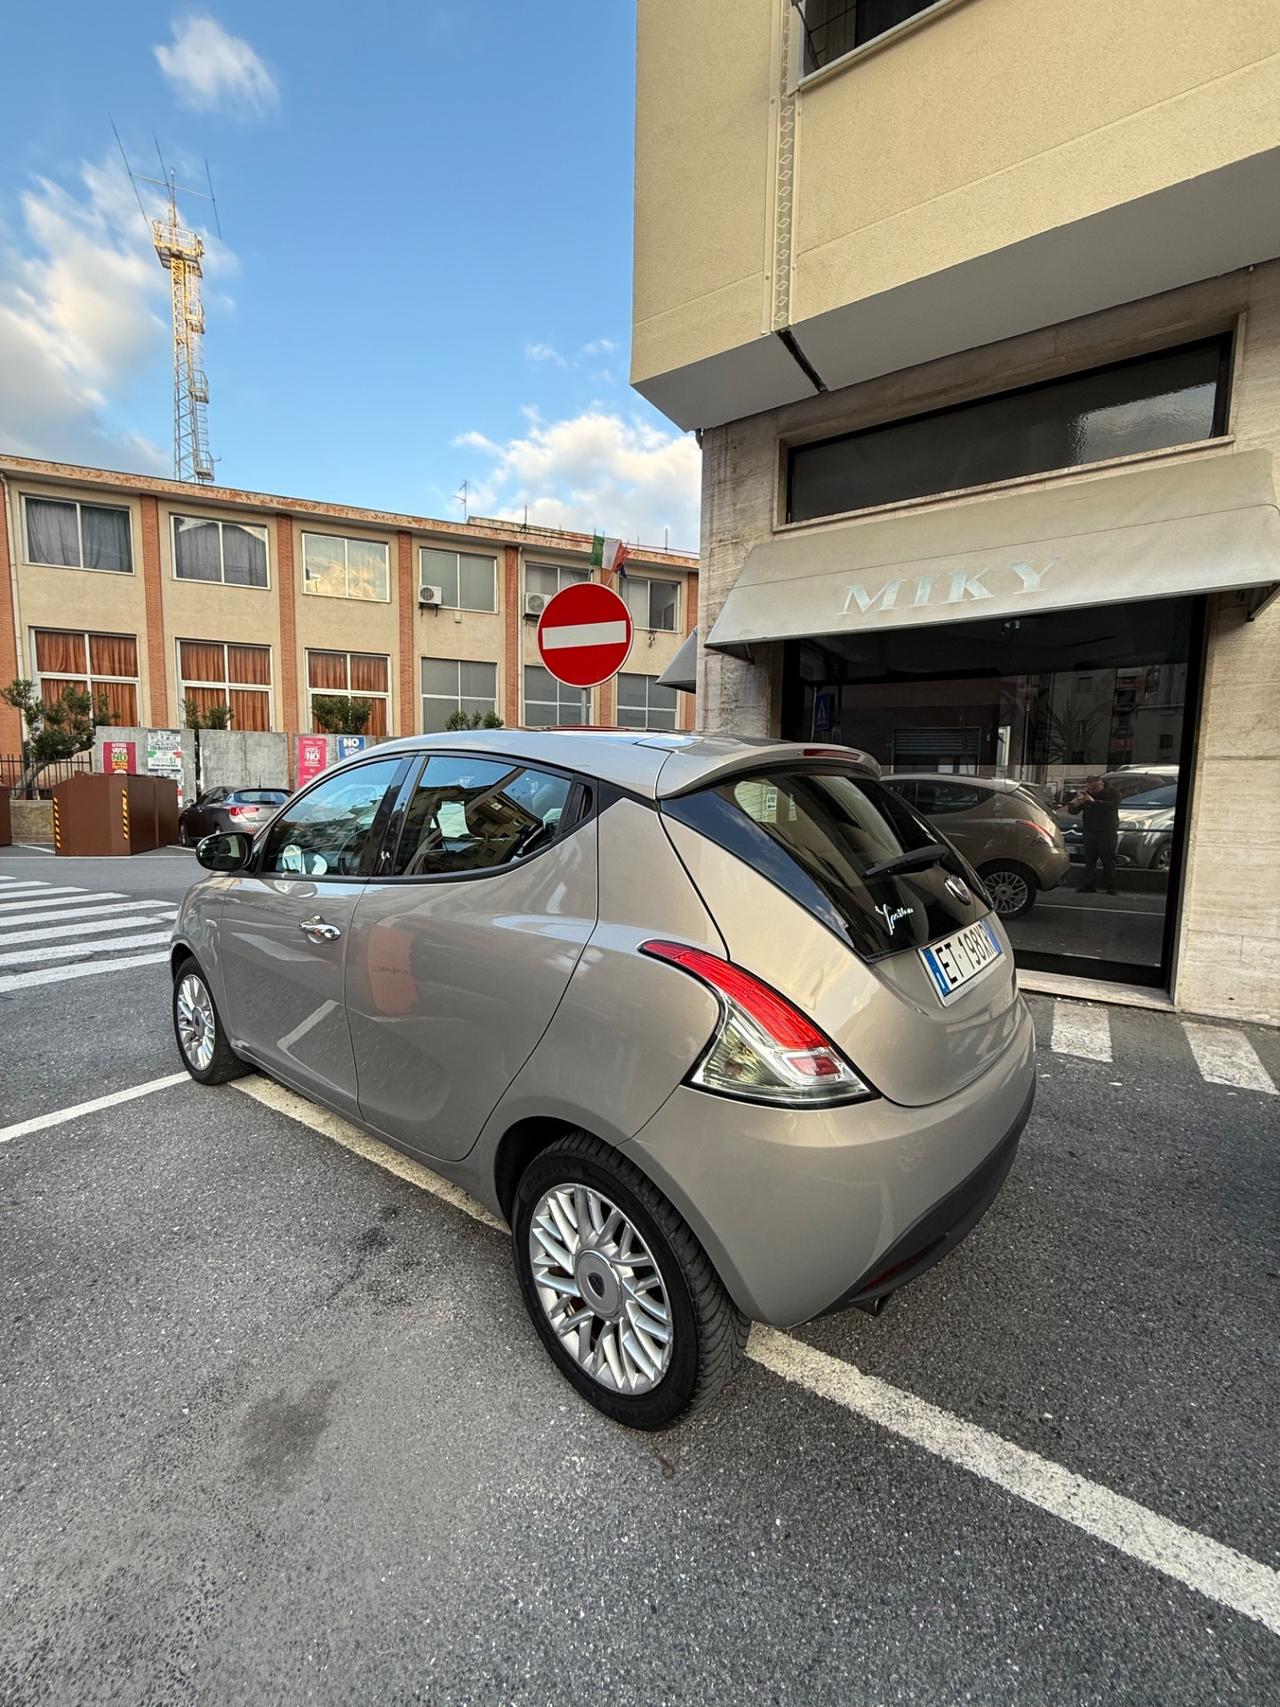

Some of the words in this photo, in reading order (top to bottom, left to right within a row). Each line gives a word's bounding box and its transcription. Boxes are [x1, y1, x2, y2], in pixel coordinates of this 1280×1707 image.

[837, 556, 1061, 615] MIKY
[343, 738, 360, 747] NO
[112, 754, 128, 762] NO
[934, 942, 964, 985] ET
